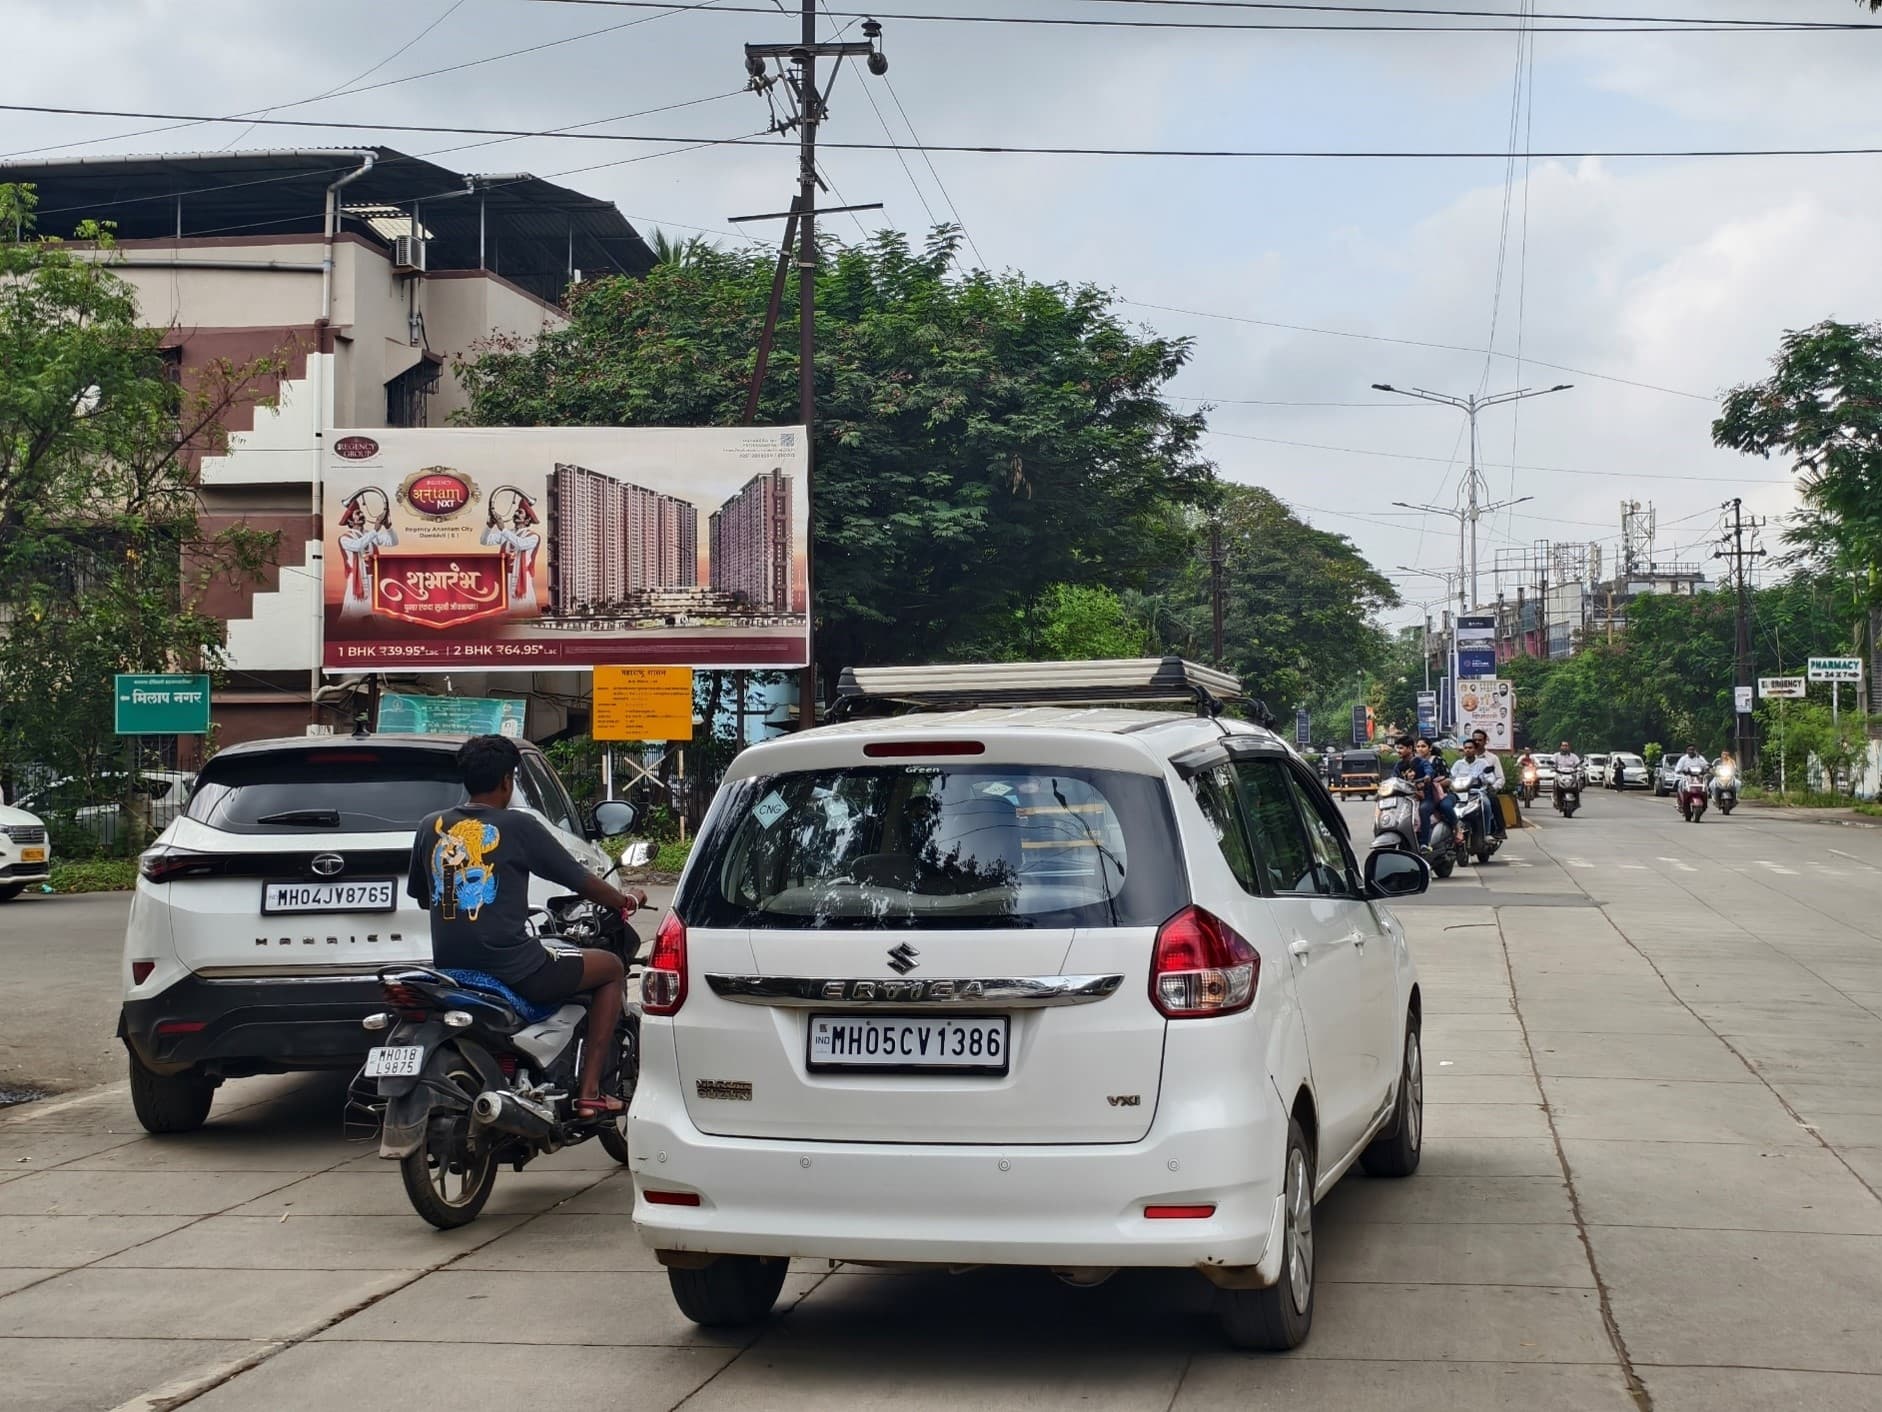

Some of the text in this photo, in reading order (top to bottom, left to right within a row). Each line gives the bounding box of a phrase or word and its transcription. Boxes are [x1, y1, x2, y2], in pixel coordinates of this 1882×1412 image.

[437, 499, 455, 509] NXT
[380, 562, 499, 602] शुभारंभ
[338, 647, 344, 657] 1
[348, 646, 376, 657] BHK
[454, 645, 461, 656] 2
[464, 645, 494, 656] BHK
[1811, 660, 1860, 669] PHARMACY
[132, 688, 202, 704] मिलाप नगर
[905, 766, 940, 774] Green
[759, 804, 782, 816] CNG
[278, 886, 390, 906] MH04JV8765
[821, 980, 986, 1000] ERTIGA
[815, 1026, 1001, 1057] IND MH05CV1386
[376, 1061, 413, 1074] L9875
[1106, 1095, 1141, 1106] VXI
